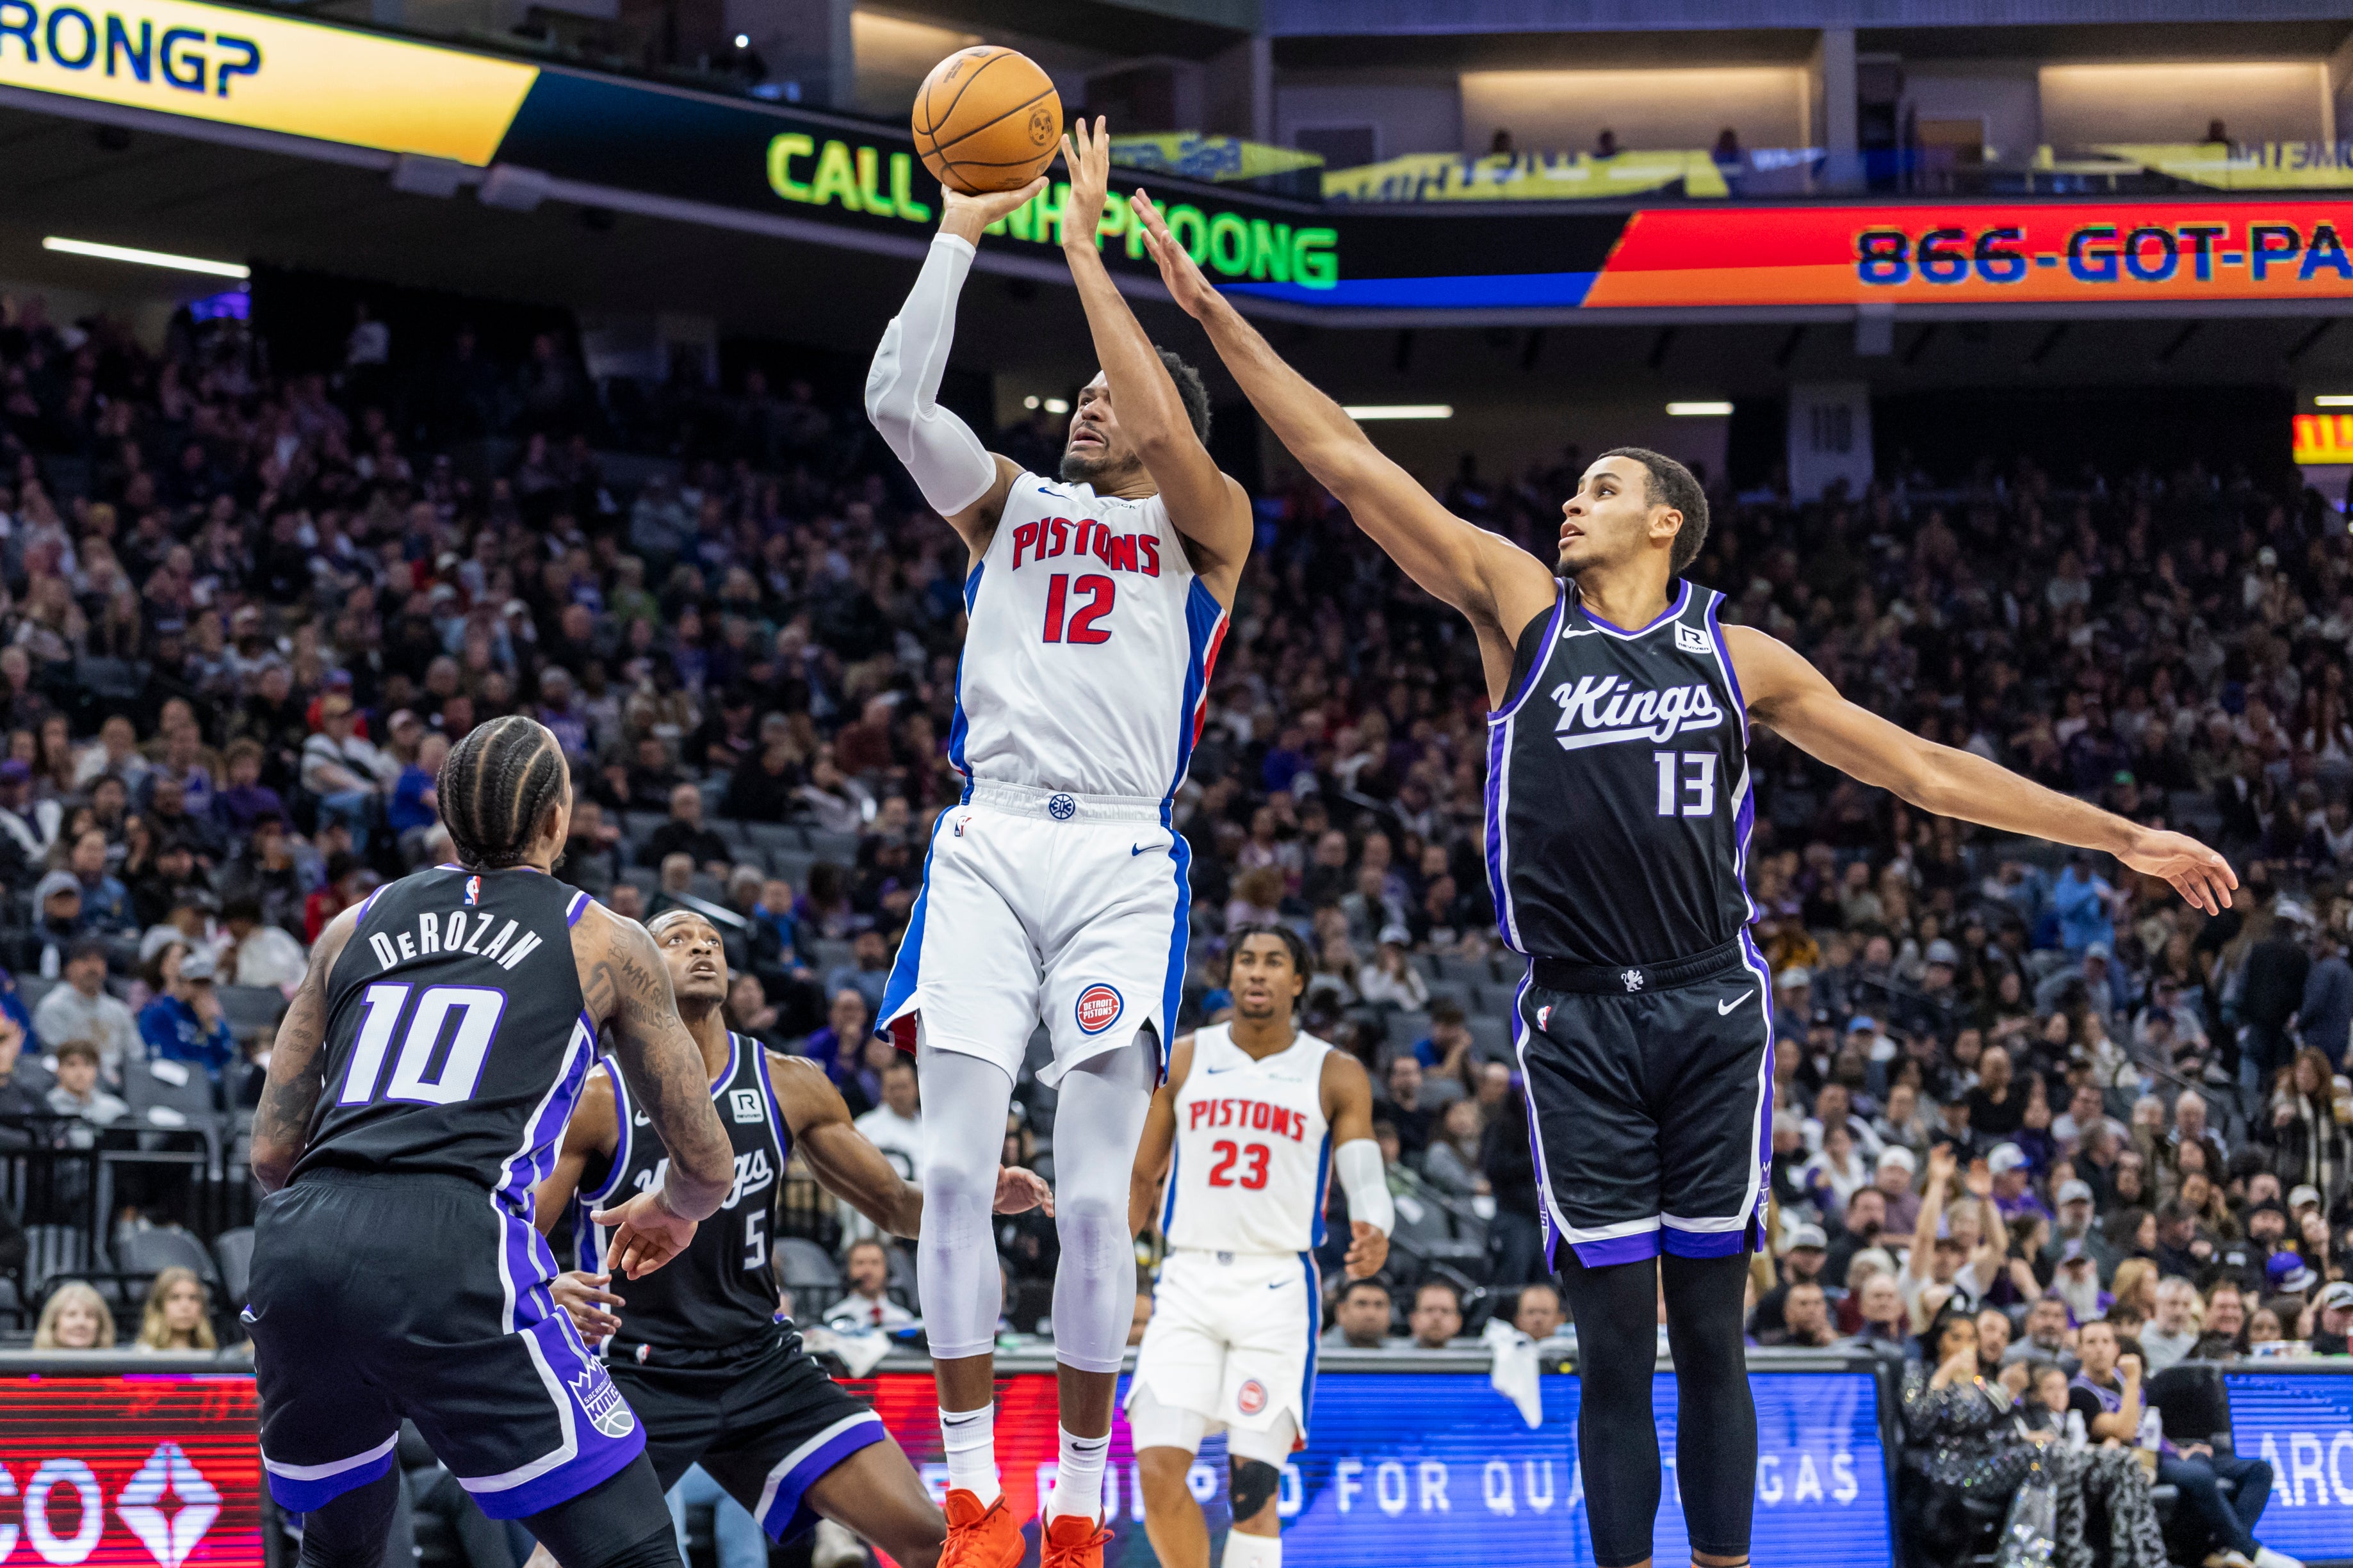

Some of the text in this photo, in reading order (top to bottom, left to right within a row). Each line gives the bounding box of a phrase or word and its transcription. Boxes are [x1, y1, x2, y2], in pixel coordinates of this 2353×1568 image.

[767, 133, 931, 223] CALL
[1012, 516, 1160, 578] PISTONS
[1043, 574, 1116, 644] 12
[1551, 674, 1723, 750] Kings
[1653, 750, 1718, 818] 13
[1082, 998, 1113, 1011] DETROIT
[1082, 1006, 1113, 1020] PISTONS
[336, 982, 508, 1107] 10
[1189, 1099, 1308, 1142] PISTONS
[1208, 1140, 1271, 1191] 23
[744, 1209, 766, 1270] 5
[1335, 1459, 1449, 1515] FOR
[1756, 1453, 1857, 1505] GAS
